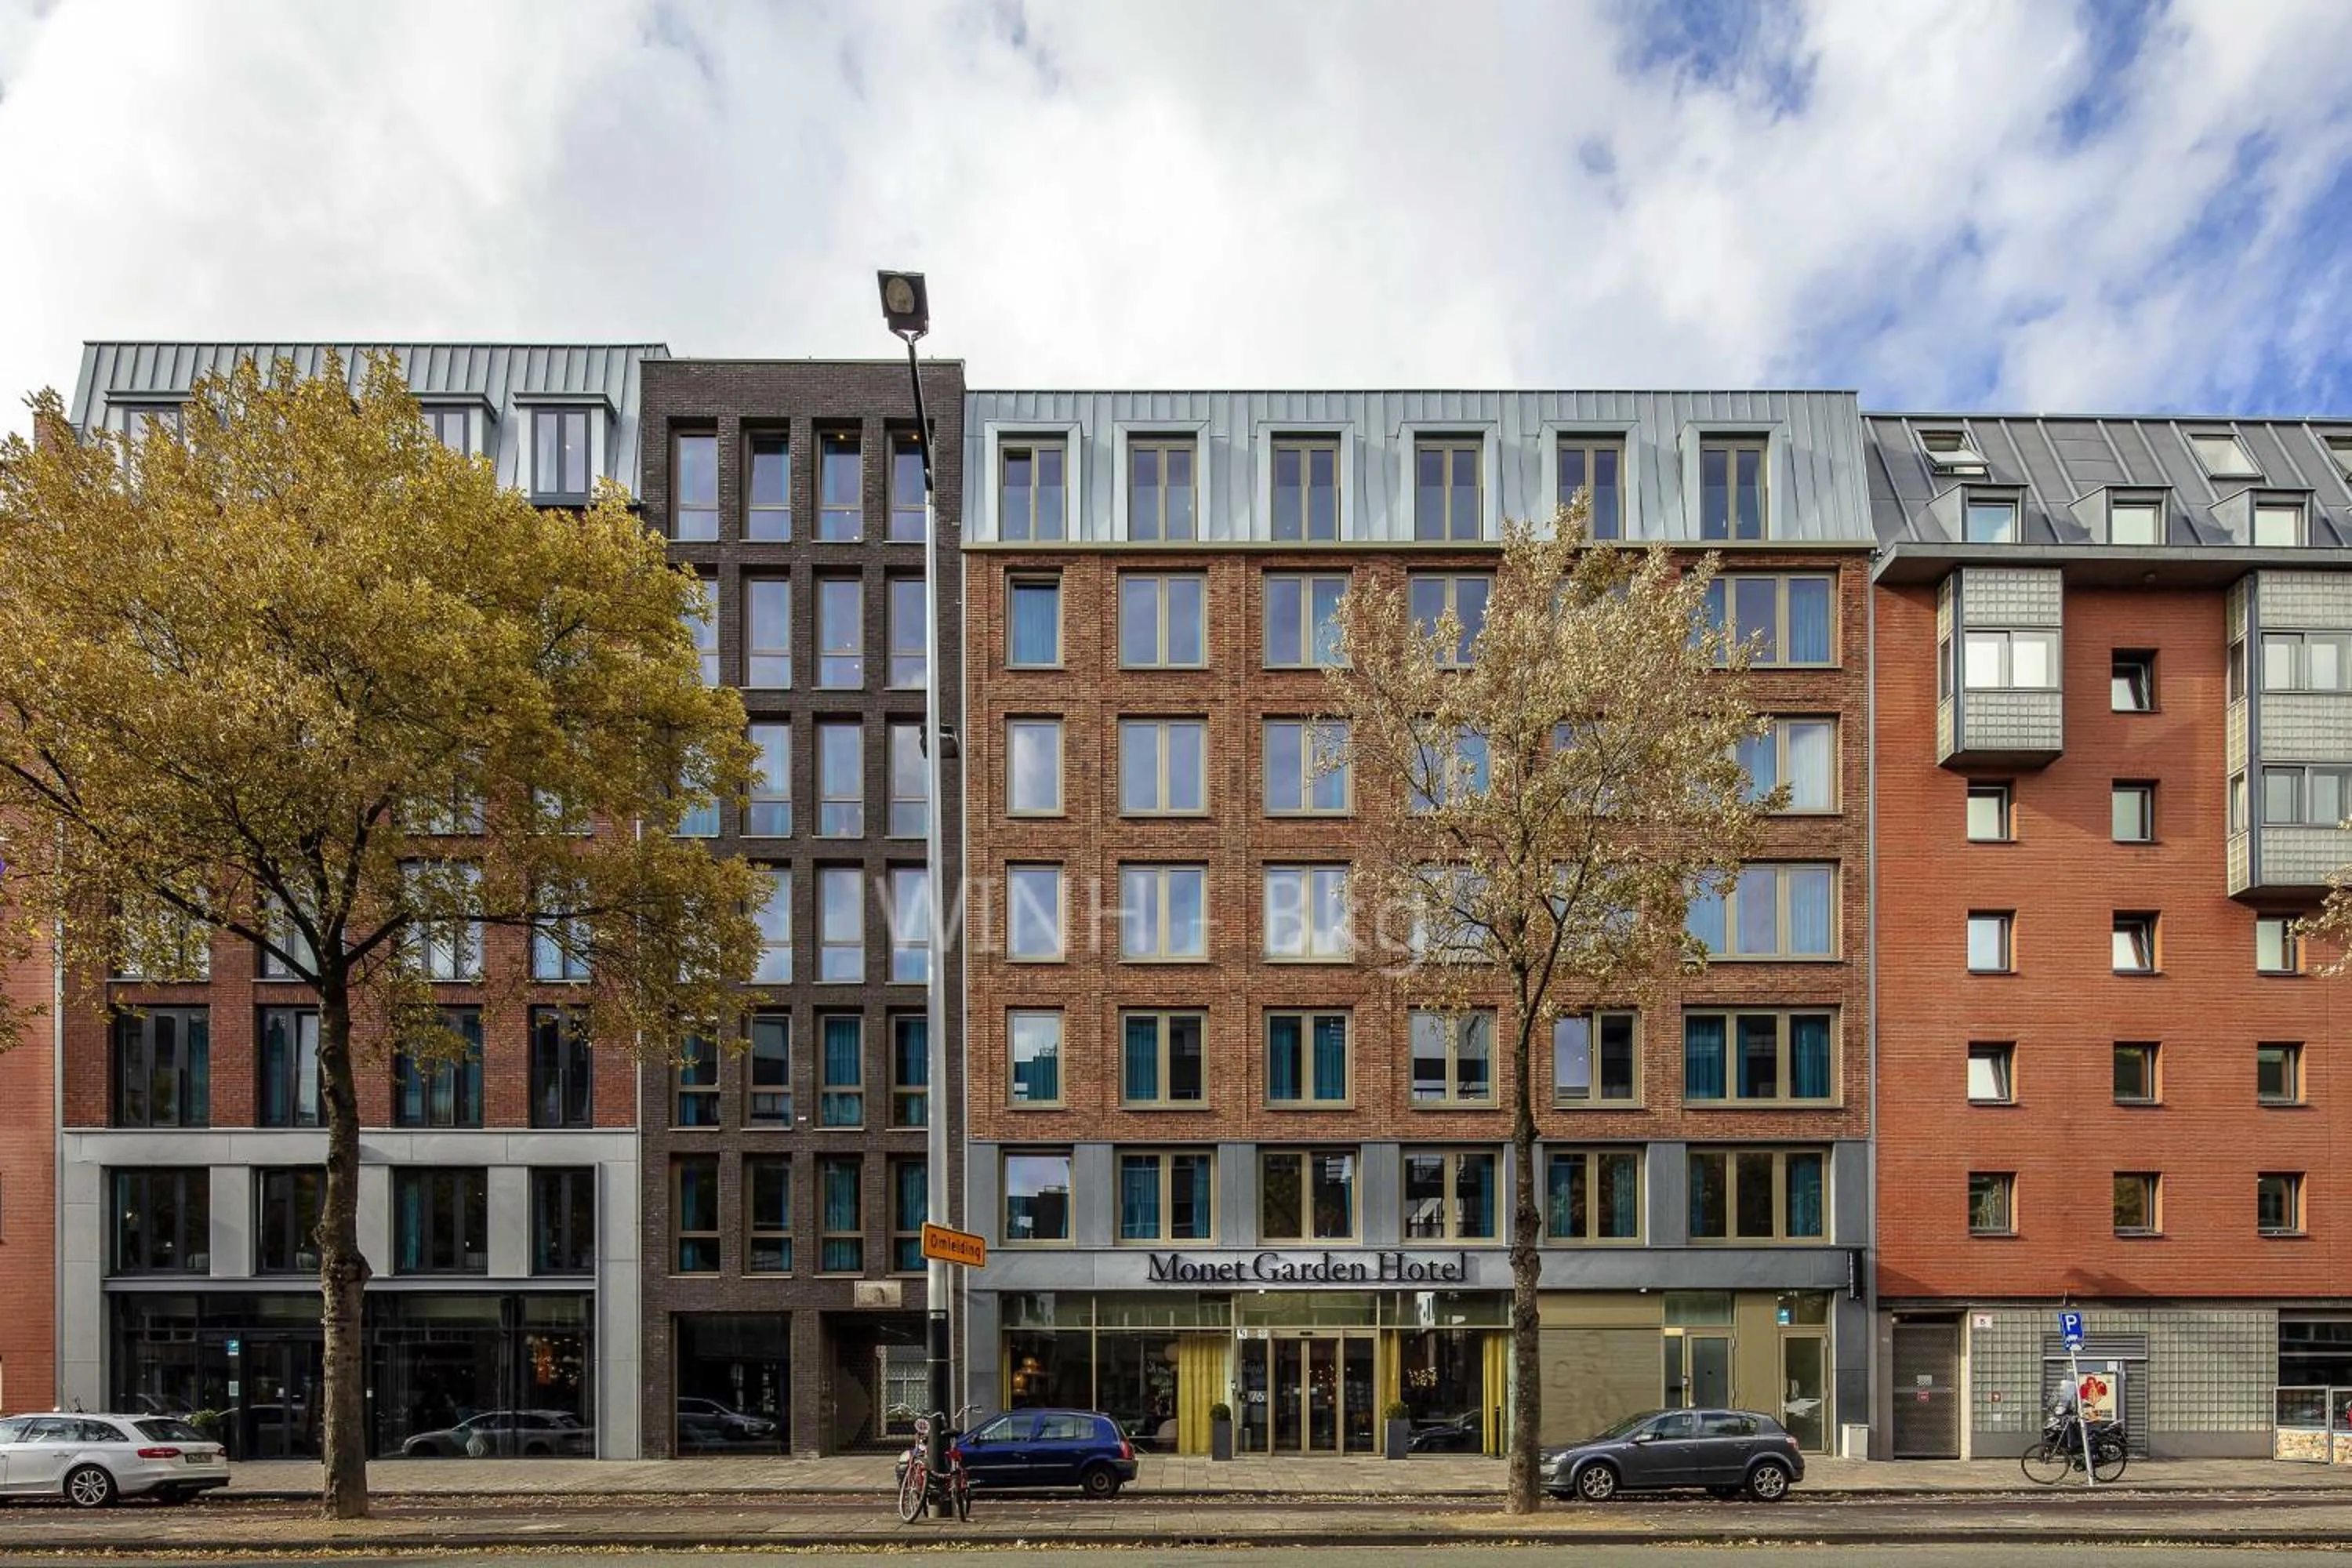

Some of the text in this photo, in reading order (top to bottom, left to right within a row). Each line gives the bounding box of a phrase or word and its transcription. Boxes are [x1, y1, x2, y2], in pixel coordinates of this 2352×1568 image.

[931, 1233, 981, 1261] Omleiding
[1146, 1251, 1467, 1281] Monet Garden Hotel
[2065, 1314, 2078, 1332] P
